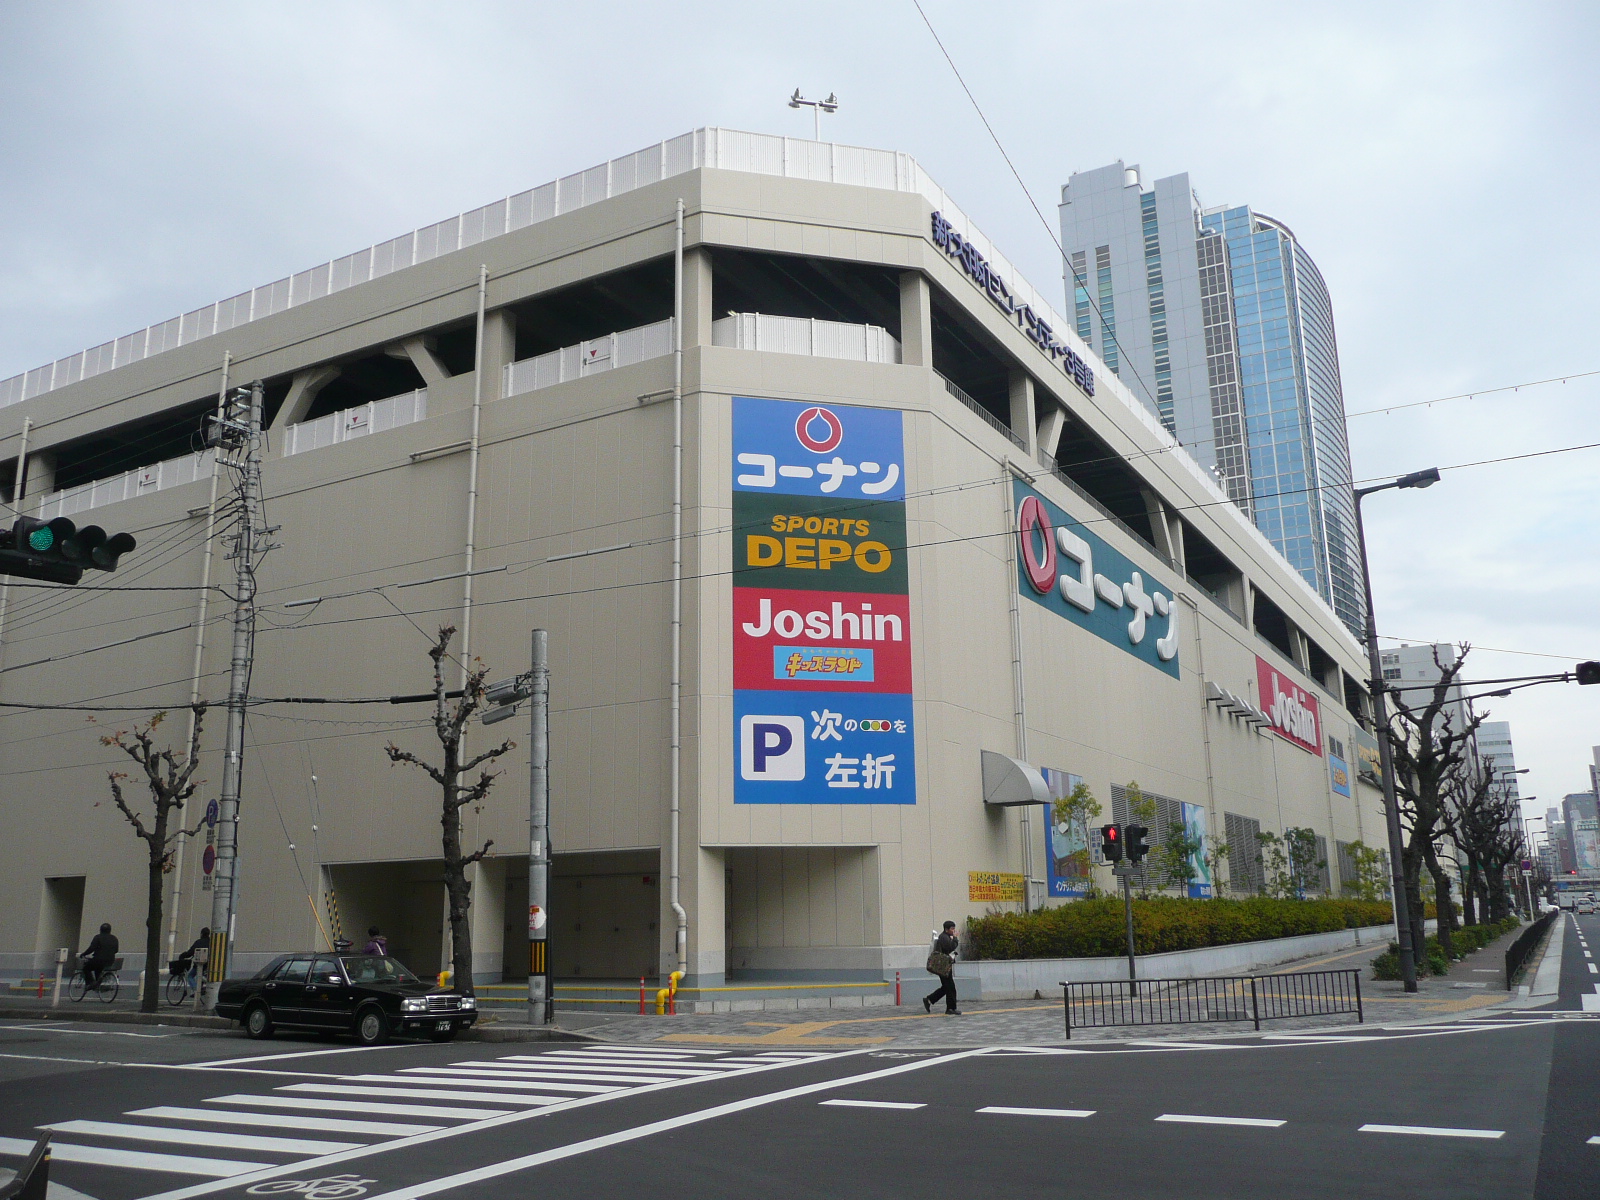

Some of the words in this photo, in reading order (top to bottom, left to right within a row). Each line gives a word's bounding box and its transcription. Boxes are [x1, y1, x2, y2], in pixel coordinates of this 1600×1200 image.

[737, 453, 900, 495] コーナン
[770, 514, 870, 537] SPORTS
[746, 534, 892, 573] DEPO
[1057, 526, 1180, 660] コーナン
[742, 598, 903, 642] Joshin
[786, 652, 863, 677] キッズランド
[811, 708, 857, 742] 次の
[893, 719, 907, 734] を
[1269, 671, 1317, 747] Joshin
[753, 722, 793, 772] P
[824, 752, 896, 790] 左折
